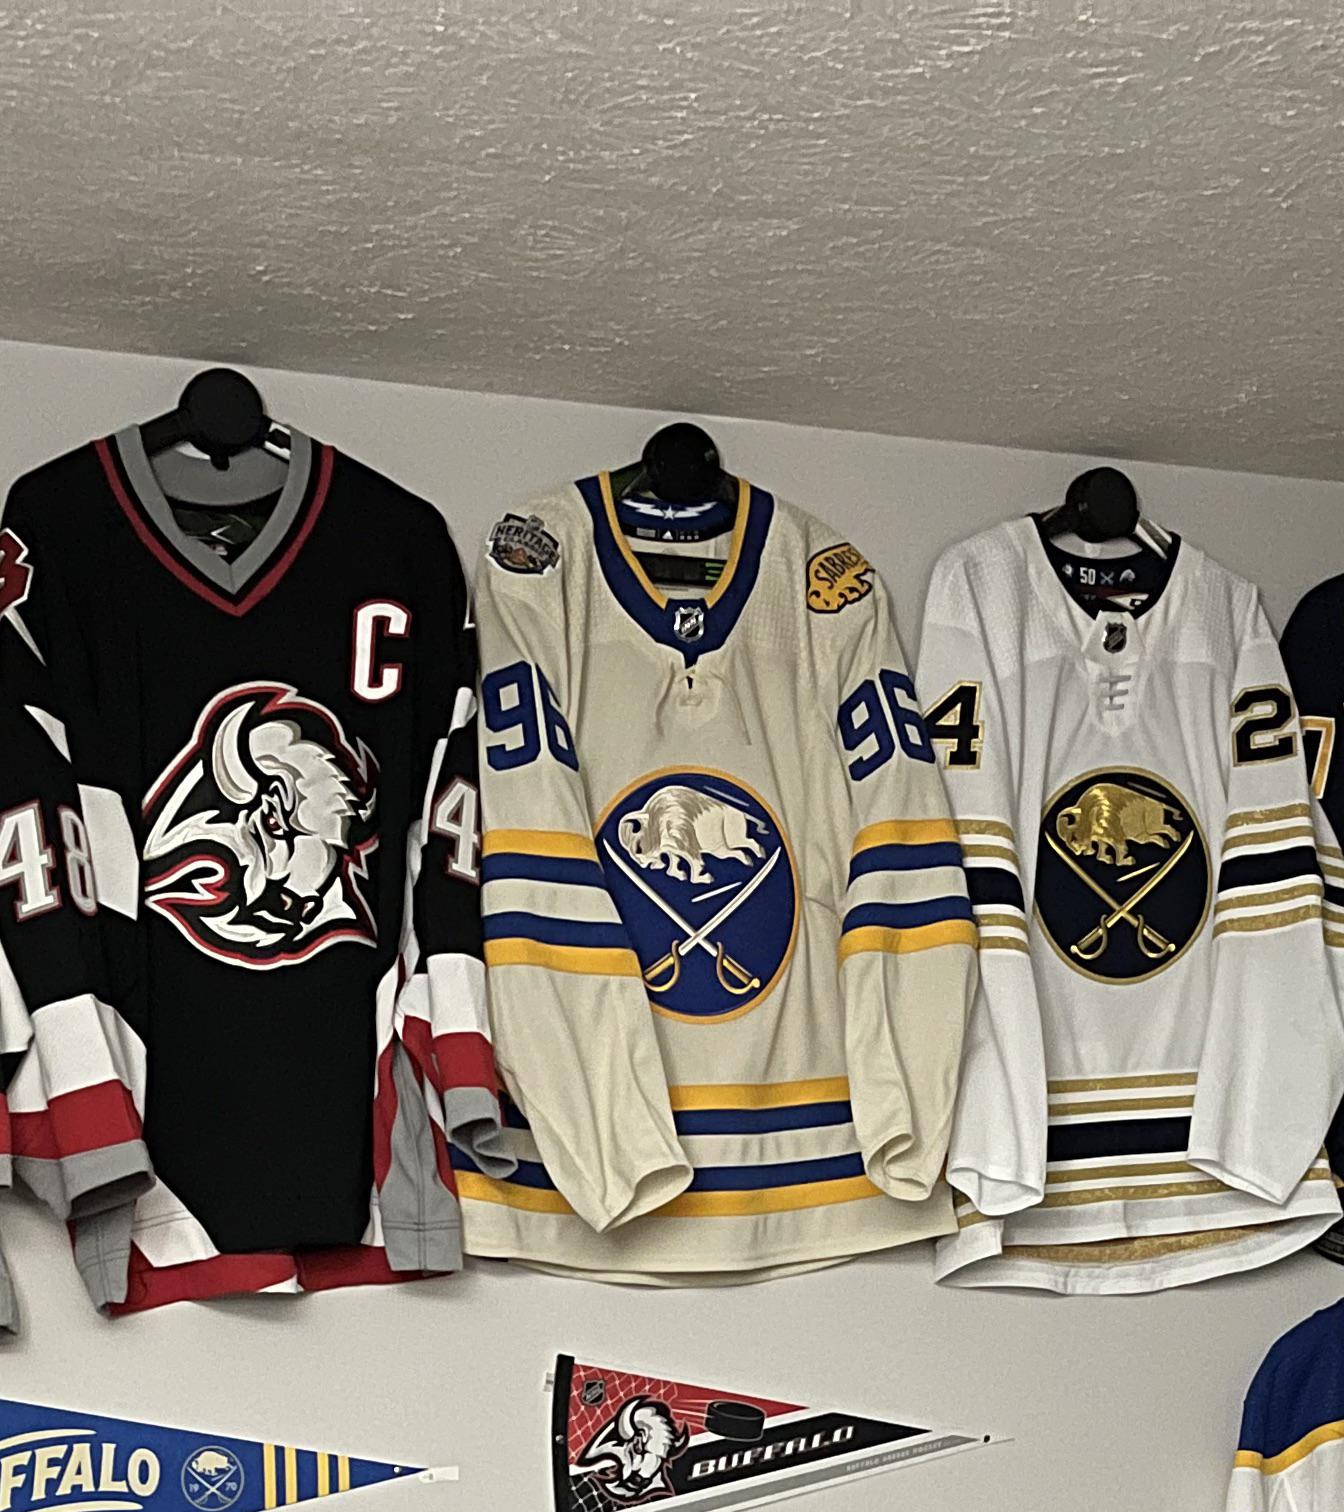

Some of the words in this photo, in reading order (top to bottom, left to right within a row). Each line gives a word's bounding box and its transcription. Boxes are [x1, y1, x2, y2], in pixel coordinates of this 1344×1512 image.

[1079, 566, 1097, 586] 50
[352, 600, 412, 701] C
[481, 660, 580, 773] 96
[837, 668, 936, 782] 96
[1230, 683, 1298, 768] 2
[687, 1425, 855, 1481] BUFFALO
